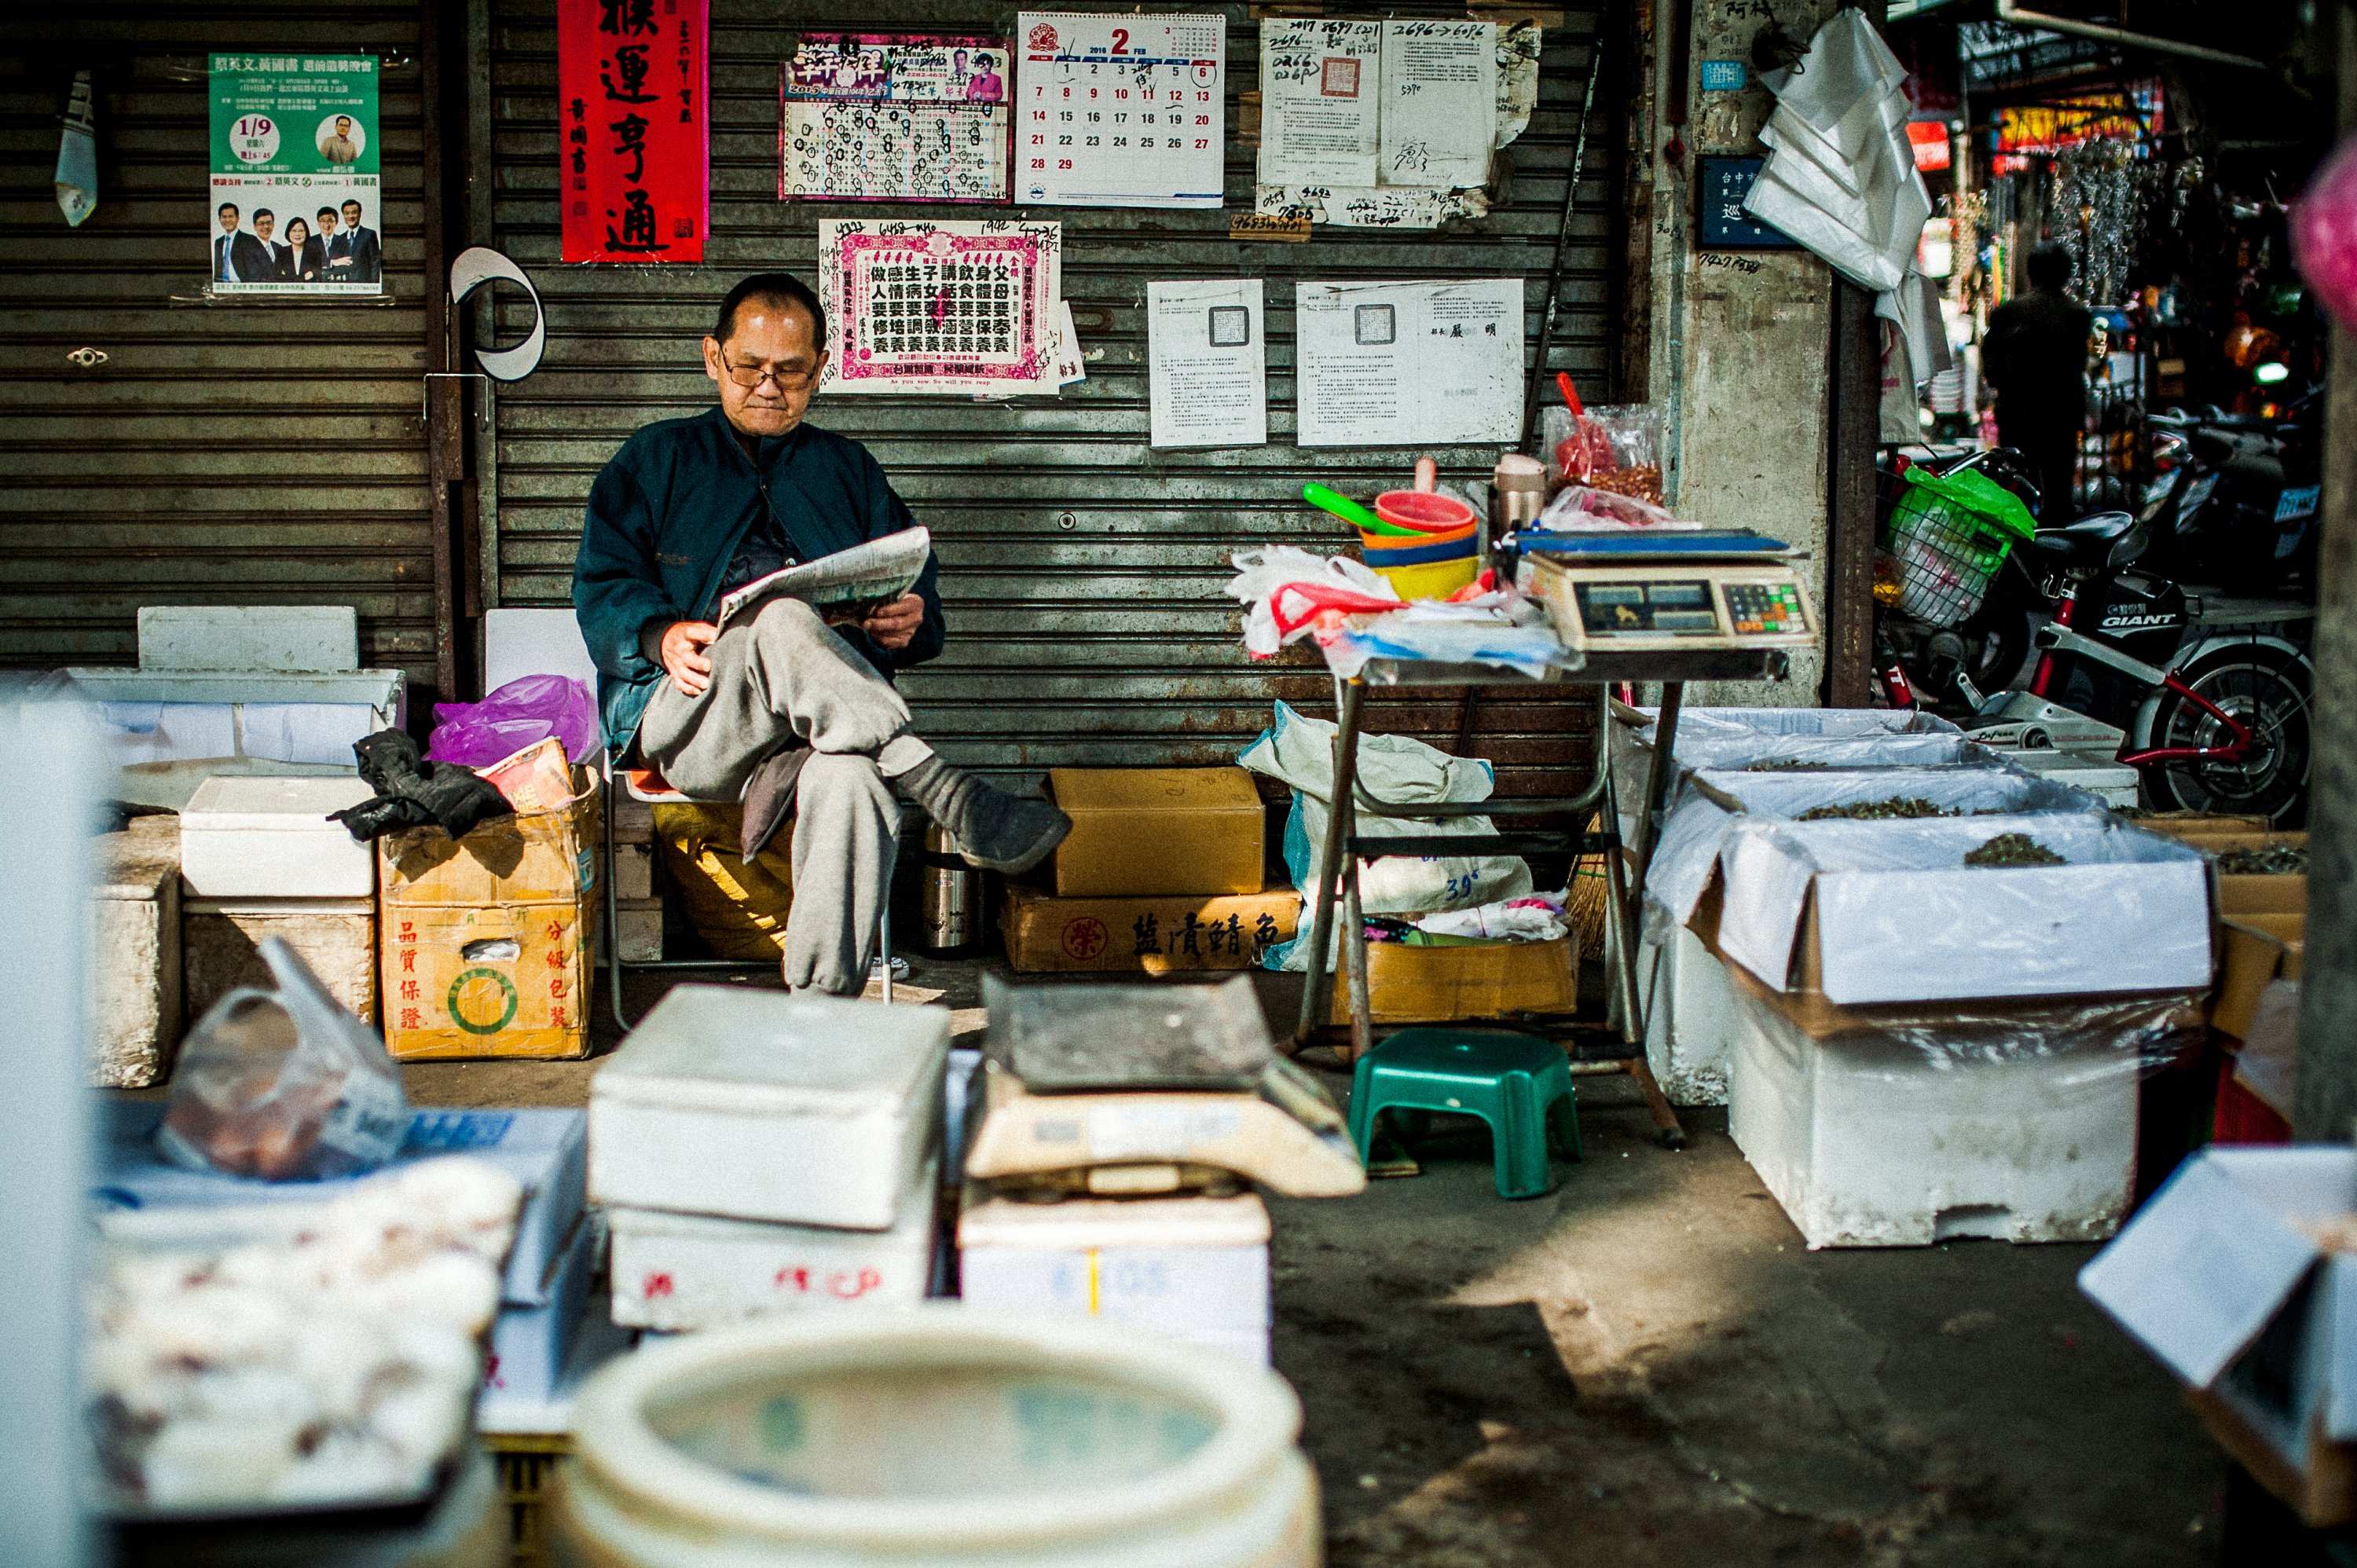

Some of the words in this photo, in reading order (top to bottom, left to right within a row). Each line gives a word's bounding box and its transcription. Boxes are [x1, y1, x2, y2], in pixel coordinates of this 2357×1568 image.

[1111, 28, 1129, 55] 2
[1064, 64, 1069, 73] 1
[1091, 65, 1098, 74] 2
[1118, 66, 1124, 75] 3
[1172, 67, 1179, 76] 5
[1200, 68, 1206, 77] 6
[1036, 87, 1043, 96] 7
[1063, 88, 1070, 97] 8
[1090, 88, 1097, 97] 9
[1114, 89, 1128, 98] 10
[1142, 90, 1154, 99] 11
[1169, 91, 1182, 101] 12
[1196, 92, 1209, 101] 13
[1032, 112, 1046, 120] 14
[1060, 112, 1072, 121] 15
[1087, 112, 1100, 122] 16
[1114, 113, 1127, 123] 17
[1142, 114, 1154, 123] 18
[1169, 115, 1182, 124] 19
[1195, 115, 1208, 125] 20
[239, 118, 271, 137] 1/9
[1032, 135, 1044, 145] 21
[1059, 136, 1072, 145] 22
[1086, 137, 1099, 146] 23
[1113, 137, 1127, 147] 24
[1141, 138, 1153, 148] 25
[1168, 138, 1181, 148] 26
[1195, 139, 1208, 148] 27
[1031, 159, 1045, 168] 28
[1058, 159, 1072, 169] 29
[2102, 614, 2176, 627] GIANT
[398, 921, 422, 1029] 品質保證
[546, 920, 567, 1028] 分級包裝
